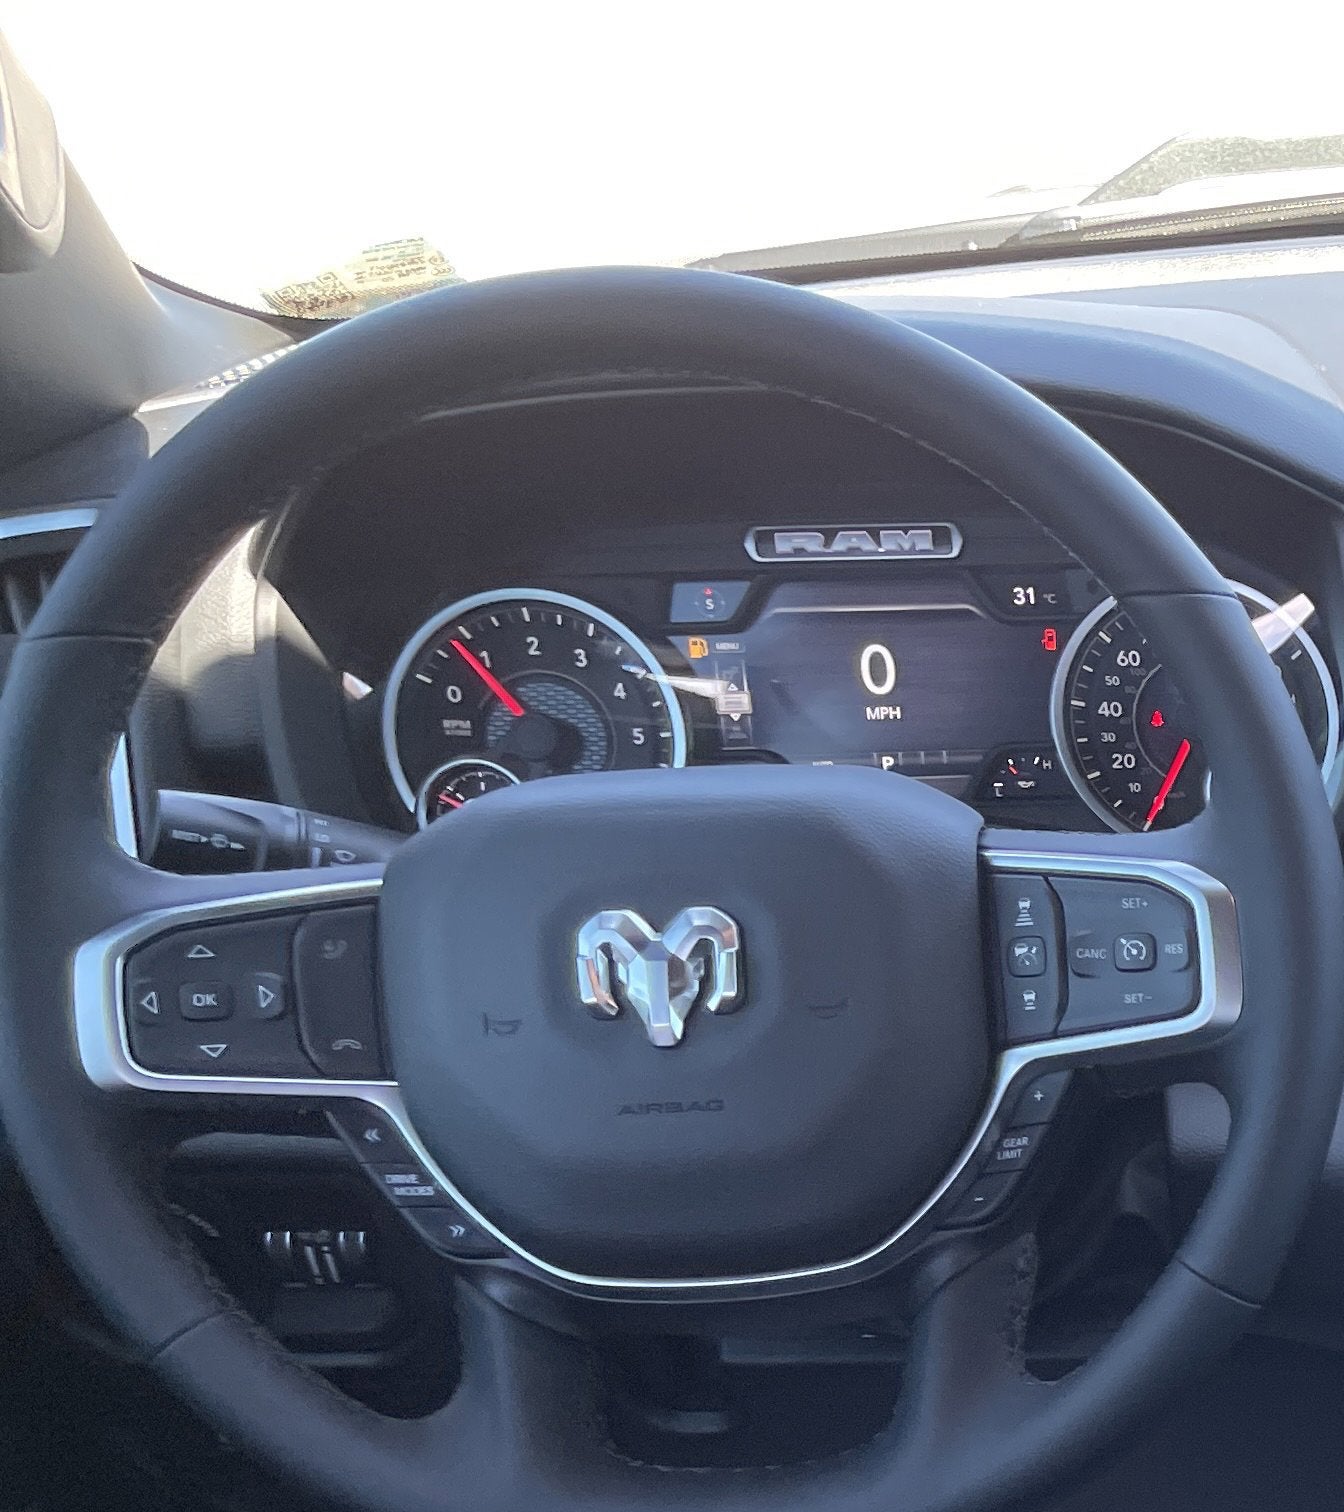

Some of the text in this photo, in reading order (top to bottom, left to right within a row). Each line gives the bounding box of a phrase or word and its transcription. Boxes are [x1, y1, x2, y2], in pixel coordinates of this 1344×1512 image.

[774, 529, 933, 553] RAM
[1012, 586, 1036, 606] 31
[704, 598, 715, 611] S
[526, 636, 542, 656] 2
[479, 650, 492, 668] 1
[574, 648, 588, 668] 3
[1116, 650, 1141, 667] 60
[859, 643, 896, 695] 0
[1104, 675, 1121, 686] 50
[445, 684, 463, 703] 0
[612, 682, 627, 700] 4
[866, 705, 902, 721] MPH
[1097, 701, 1123, 718] 40
[632, 727, 645, 745] 5
[1100, 732, 1116, 743] 30
[881, 755, 895, 771] P
[1111, 753, 1136, 769] 20
[1128, 782, 1141, 793] 10
[1076, 947, 1107, 960] CANC
[1164, 943, 1184, 955] RES
[192, 993, 218, 1008] OK
[618, 1099, 724, 1115] AIRBAG
[1002, 1136, 1030, 1148] GEAR
